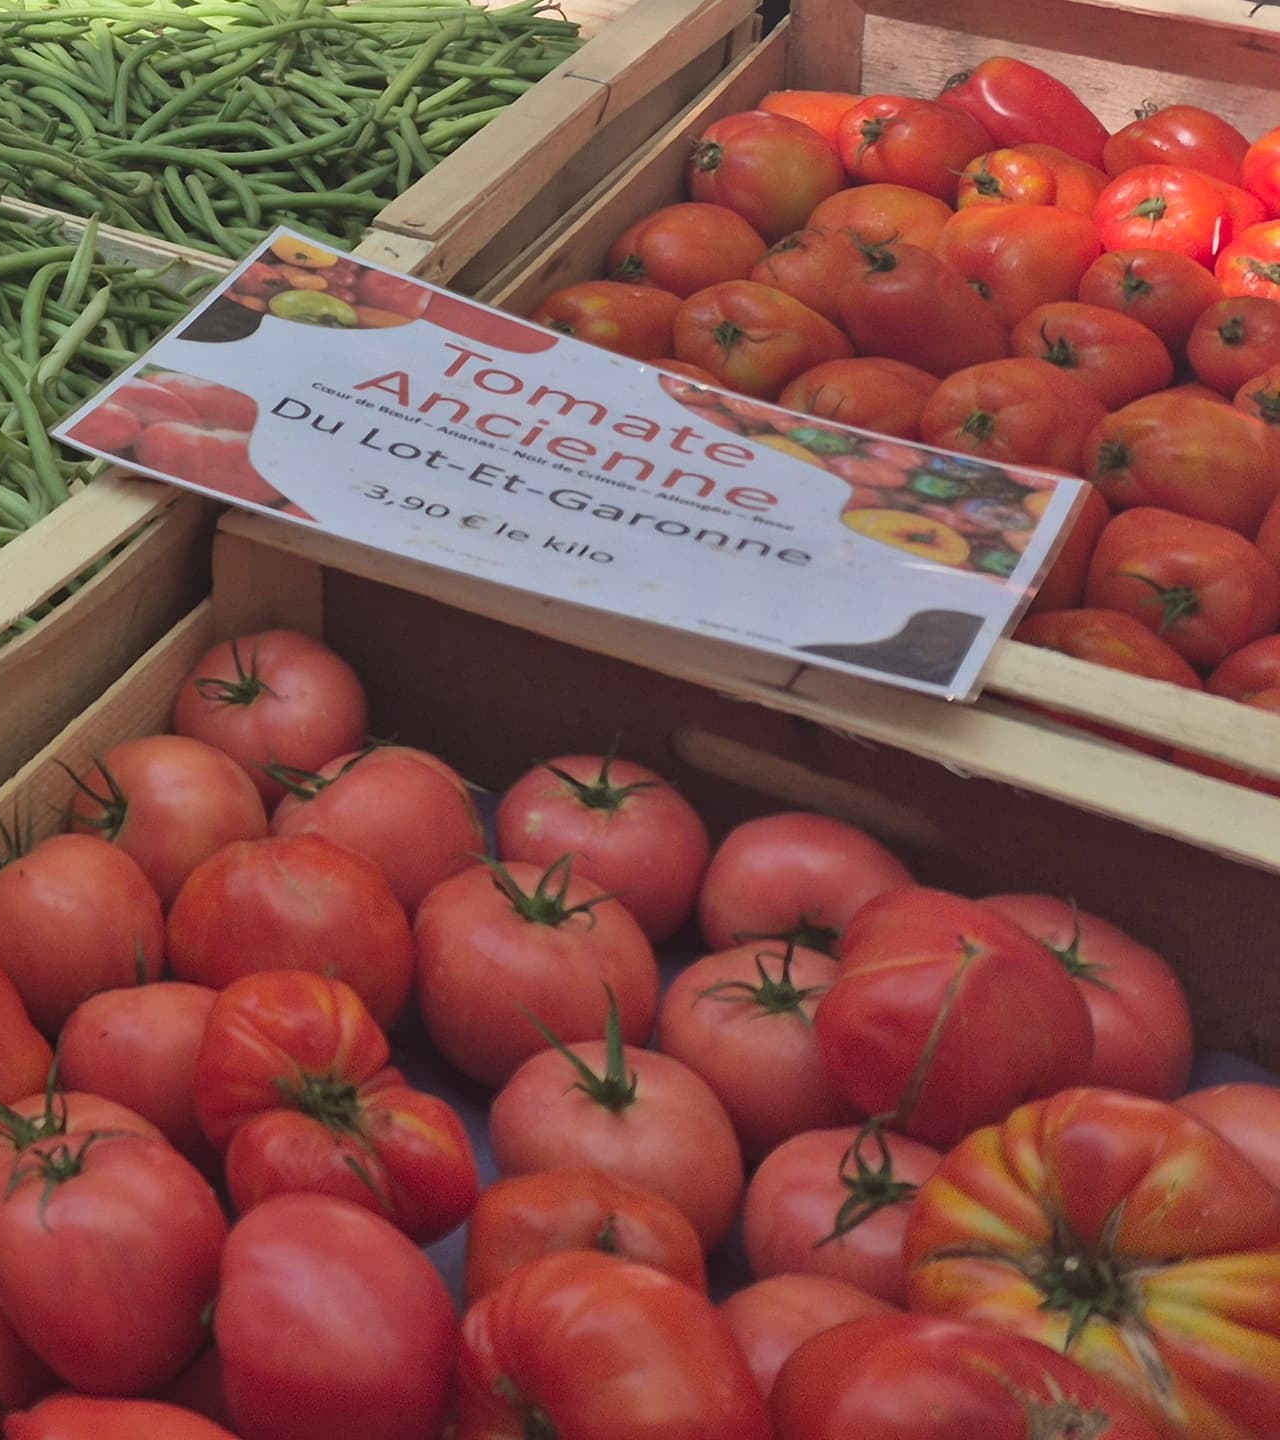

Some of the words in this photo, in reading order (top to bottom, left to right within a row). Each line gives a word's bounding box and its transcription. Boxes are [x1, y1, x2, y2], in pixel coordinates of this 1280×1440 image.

[310, 381, 353, 402] Cœur
[354, 397, 376, 410] de
[377, 405, 424, 425] Bœuf
[436, 425, 496, 450] Ananas
[513, 449, 550, 467] Noir
[551, 462, 573, 474] de
[577, 468, 639, 493] Crimée
[654, 491, 733, 518] Allongée
[751, 514, 796, 532] Rose
[352, 370, 779, 512] Ancienne
[443, 341, 756, 469] Tomate
[270, 396, 346, 436] Du
[358, 426, 814, 568] Lot-Et-Garonne
[362, 482, 452, 520] 3,90
[457, 508, 488, 531] €
[493, 522, 531, 543] le
[541, 534, 615, 564] kilo
